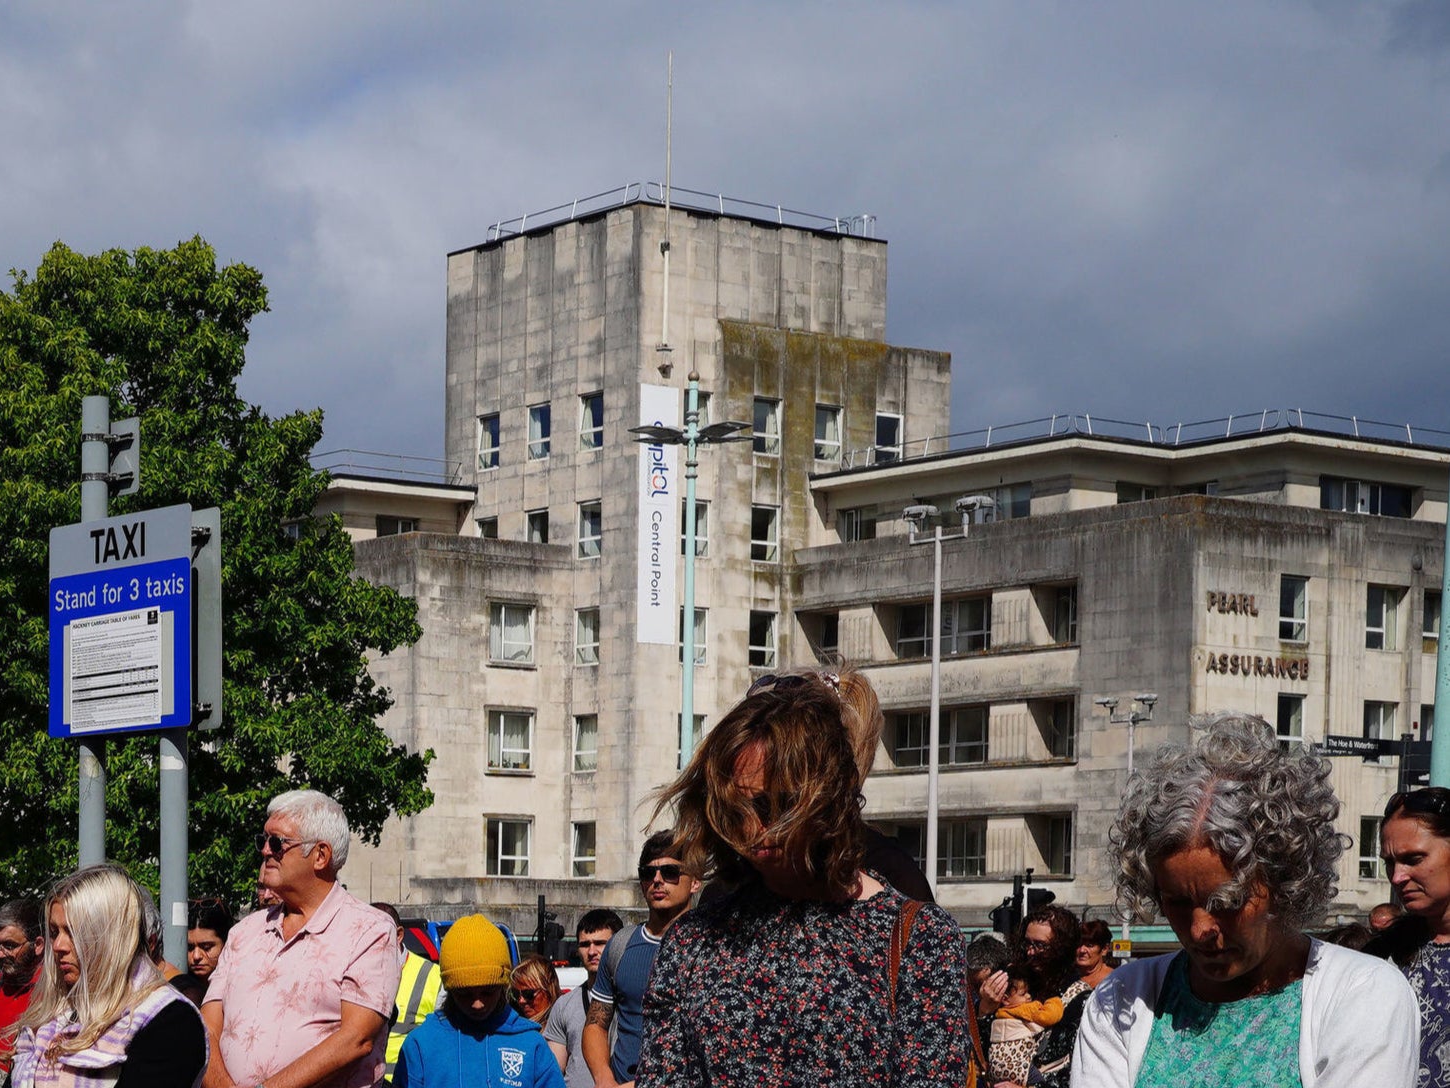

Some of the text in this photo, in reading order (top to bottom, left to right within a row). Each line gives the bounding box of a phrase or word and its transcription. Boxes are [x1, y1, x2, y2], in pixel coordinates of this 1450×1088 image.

[648, 421, 669, 498] pitol
[90, 521, 146, 565] TAXI
[651, 510, 662, 607] Central Point
[55, 572, 185, 612] Stand for 3 taxis
[1206, 591, 1259, 618] PEARL
[1206, 652, 1309, 680] ASSURANCE
[1328, 739, 1338, 747] The
[1338, 740, 1348, 748] Hoe
[1349, 740, 1353, 748] &
